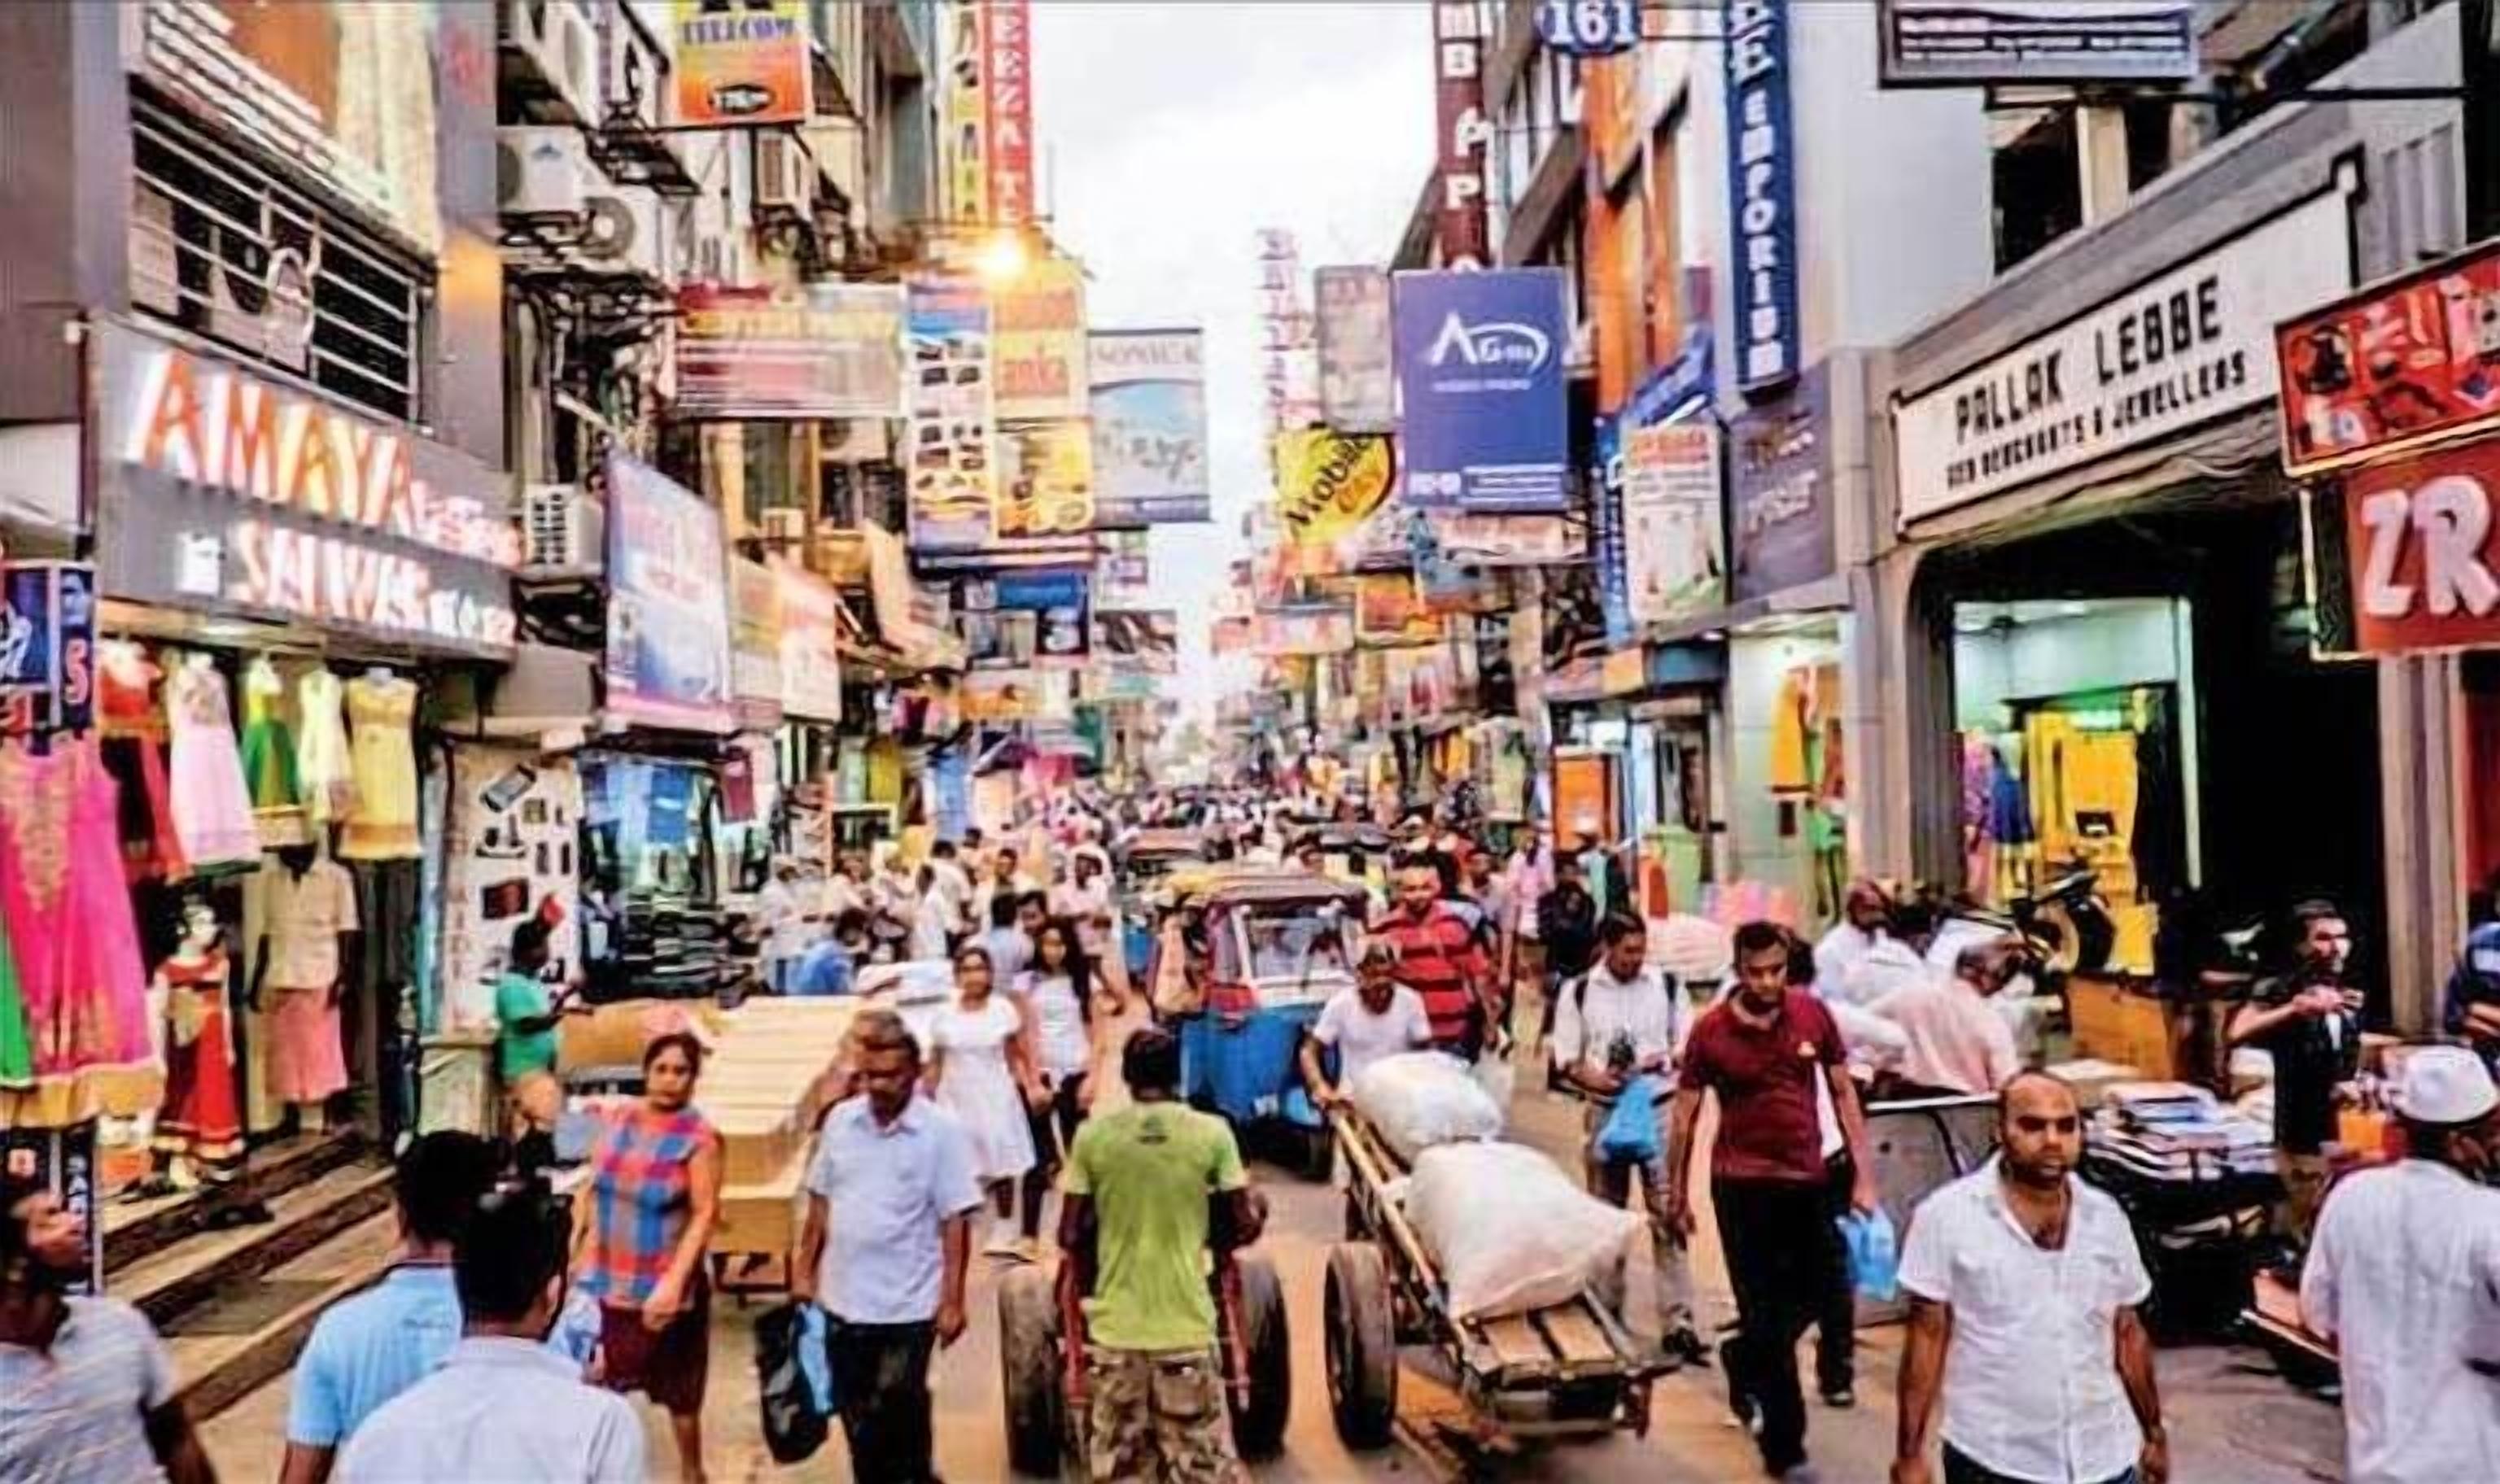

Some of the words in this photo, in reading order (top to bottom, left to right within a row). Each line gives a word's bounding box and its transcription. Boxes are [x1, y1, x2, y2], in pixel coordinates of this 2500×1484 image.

[1548, 0, 1635, 43] 161
[123, 348, 414, 535] AMAYA
[1956, 349, 2061, 444] PALLAK
[2095, 275, 2222, 386] LEBBE
